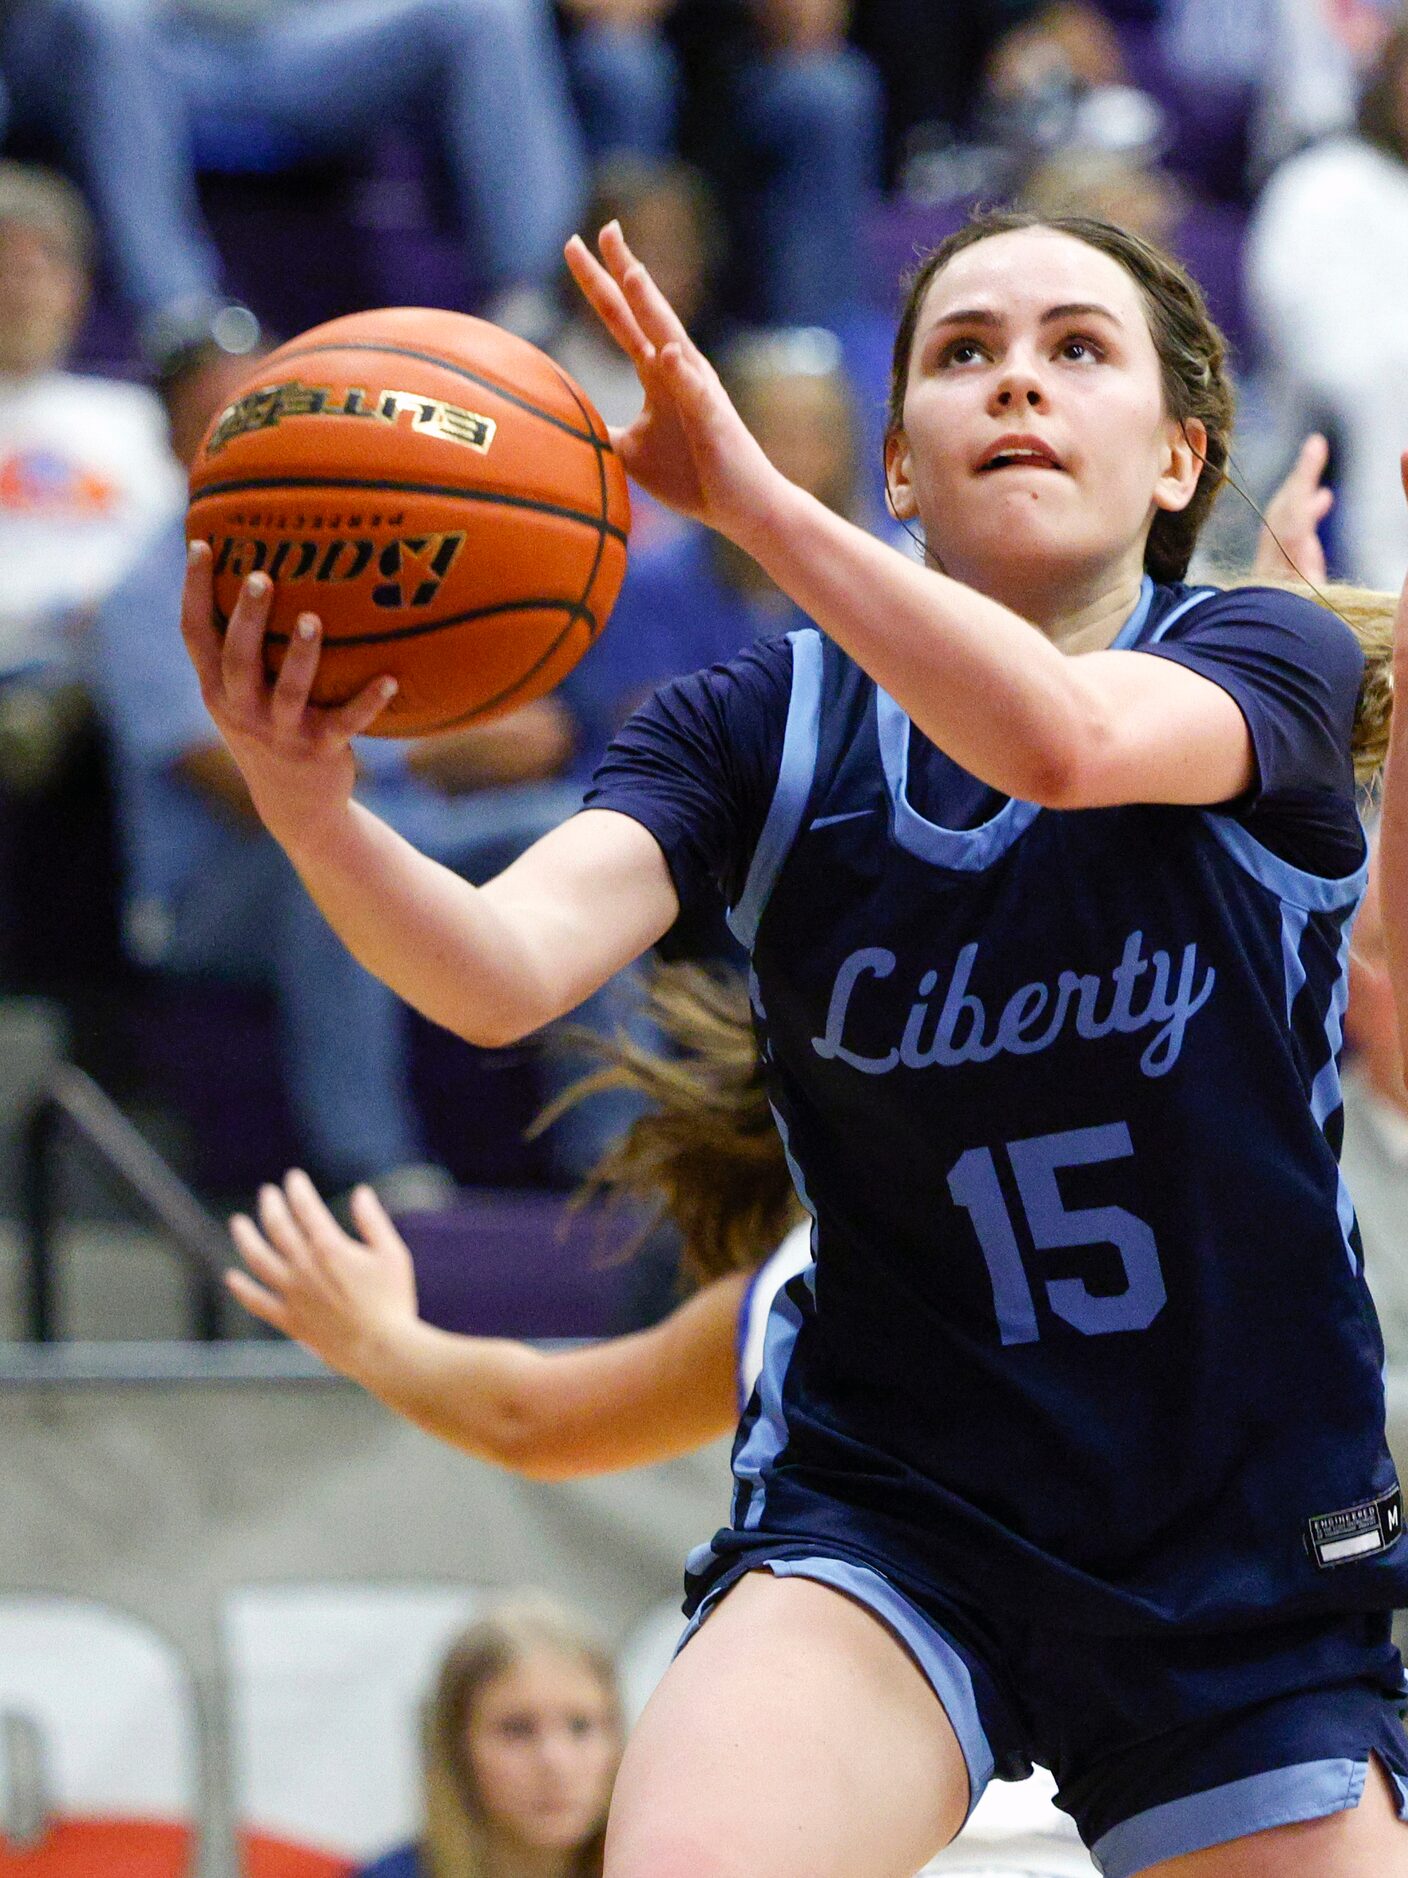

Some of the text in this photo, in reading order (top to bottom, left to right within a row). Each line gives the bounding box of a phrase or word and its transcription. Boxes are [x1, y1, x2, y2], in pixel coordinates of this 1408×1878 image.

[811, 930, 1216, 1078] Liberty
[946, 1120, 1167, 1346] 15
[1387, 1504, 1399, 1532] M
